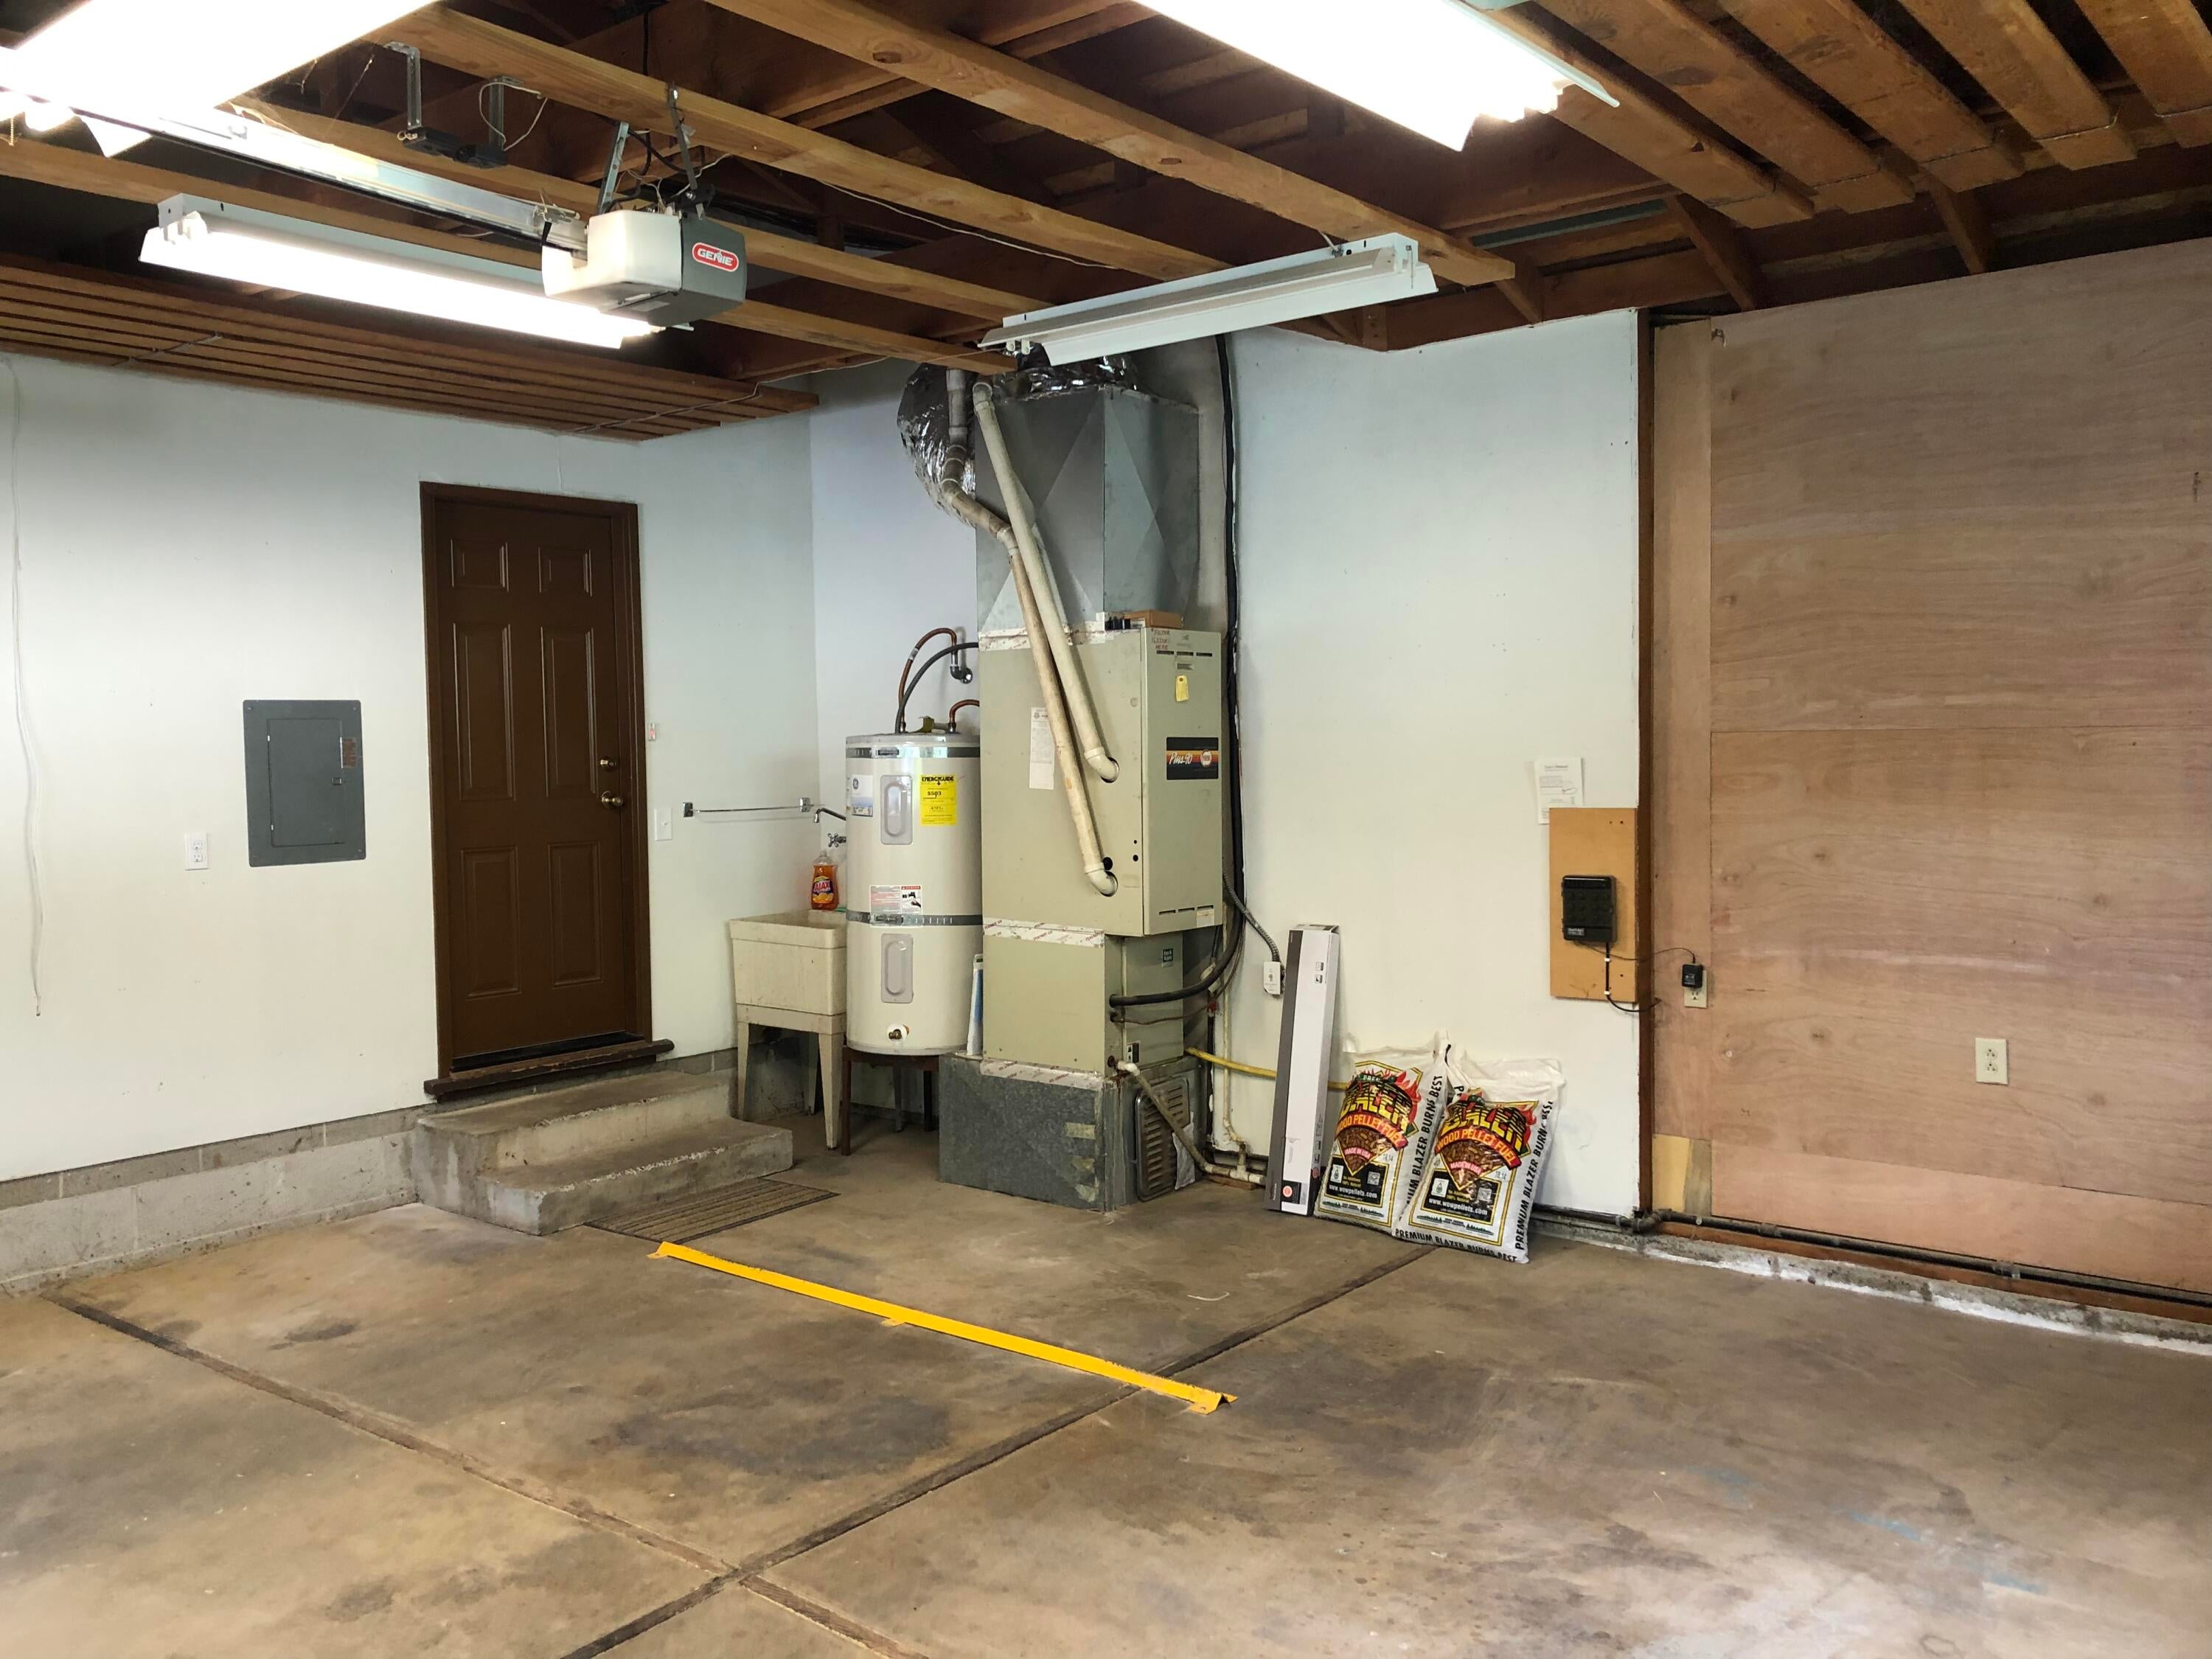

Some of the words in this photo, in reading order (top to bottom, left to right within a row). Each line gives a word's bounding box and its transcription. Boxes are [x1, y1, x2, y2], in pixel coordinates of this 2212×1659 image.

[698, 248, 734, 267] GENIE
[1354, 1114, 1383, 1130] PELLET
[1382, 1124, 1401, 1147] FUEL
[1412, 1138, 1428, 1176] BLAZER
[1422, 1099, 1436, 1134] BURNS
[1429, 1075, 1443, 1098] BEST
[1437, 1131, 1460, 1151] WOOD
[1461, 1128, 1496, 1147] PELLET
[1495, 1144, 1516, 1166] FUEL
[1515, 1200, 1529, 1251] PREMIUM
[1523, 1159, 1539, 1199] BLAZER
[1395, 1228, 1433, 1242] PREMIUM
